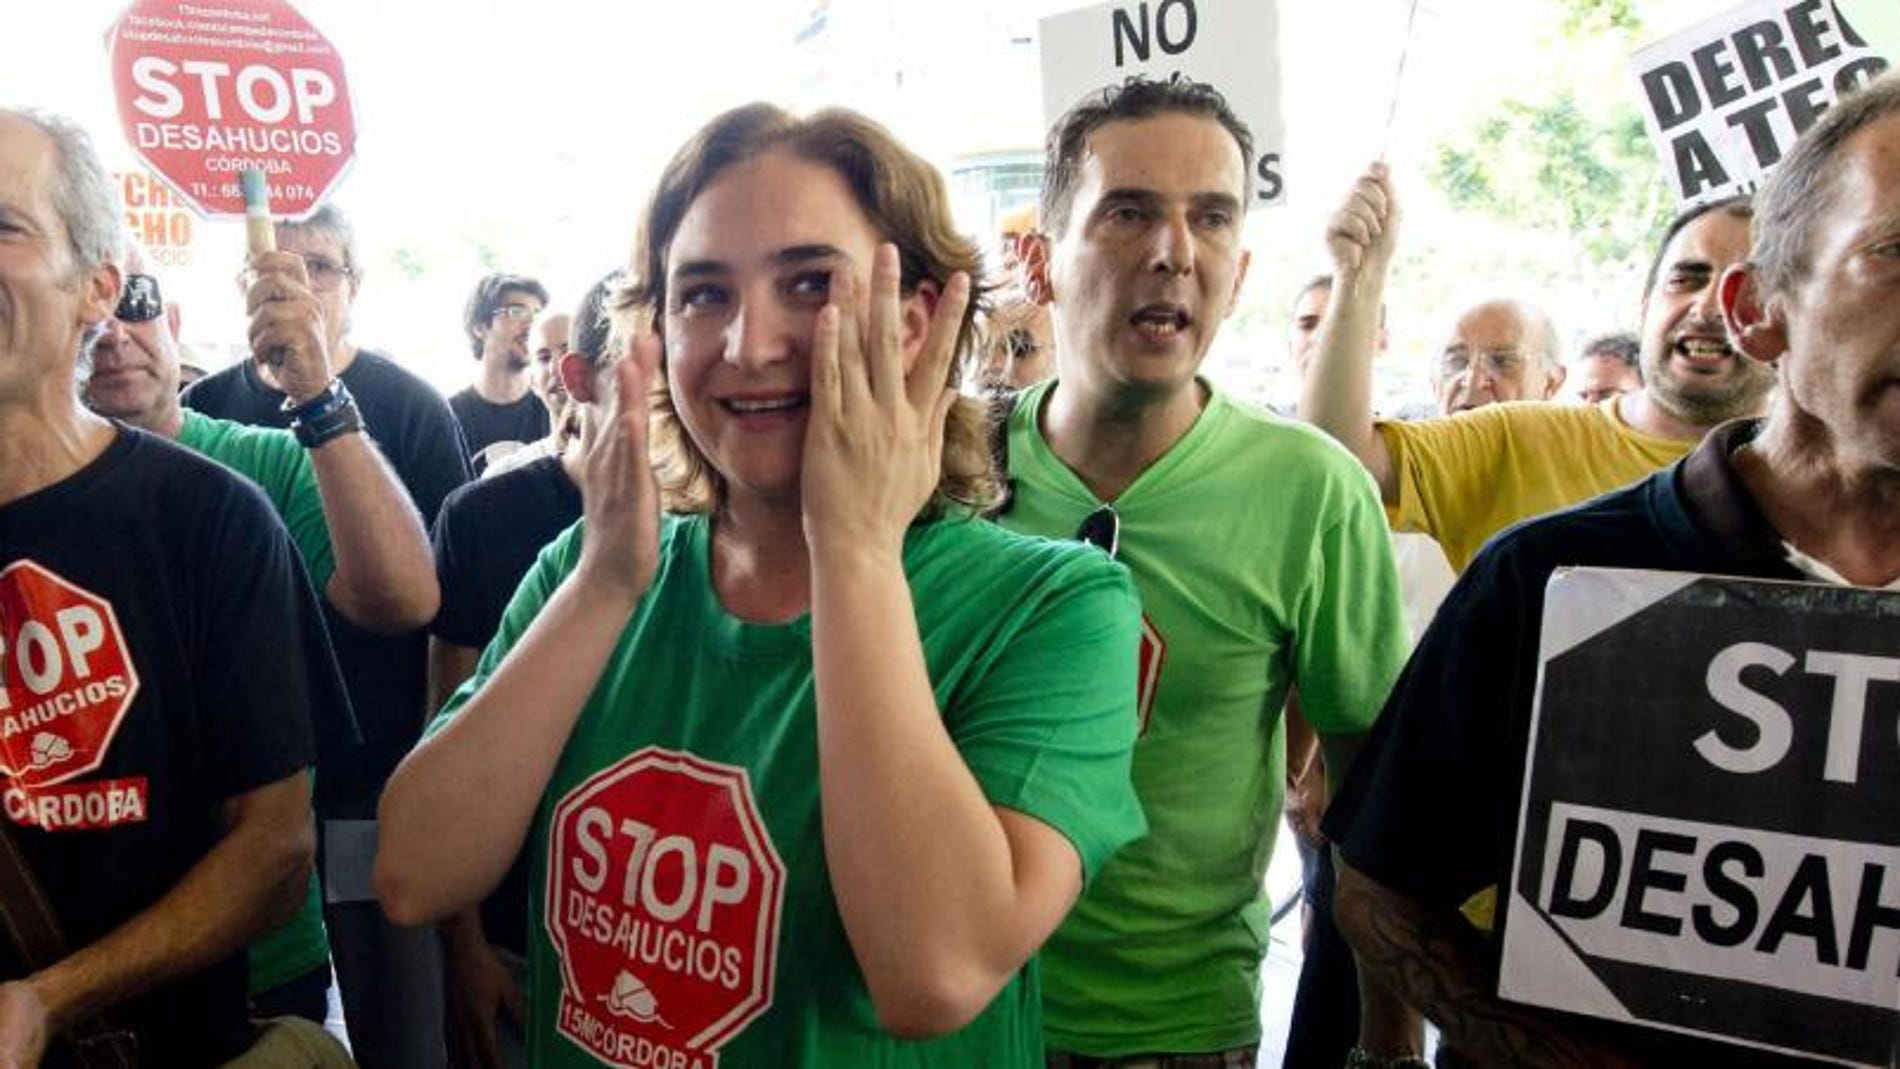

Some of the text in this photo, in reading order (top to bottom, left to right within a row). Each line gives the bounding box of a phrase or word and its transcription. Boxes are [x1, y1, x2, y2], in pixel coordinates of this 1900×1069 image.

[1112, 0, 1198, 67] NO
[132, 55, 336, 124] STOP
[136, 122, 342, 155] DESAHUCIOS
[1671, 129, 1731, 200] A
[1693, 641, 1900, 783] ST
[572, 805, 751, 932] STOP
